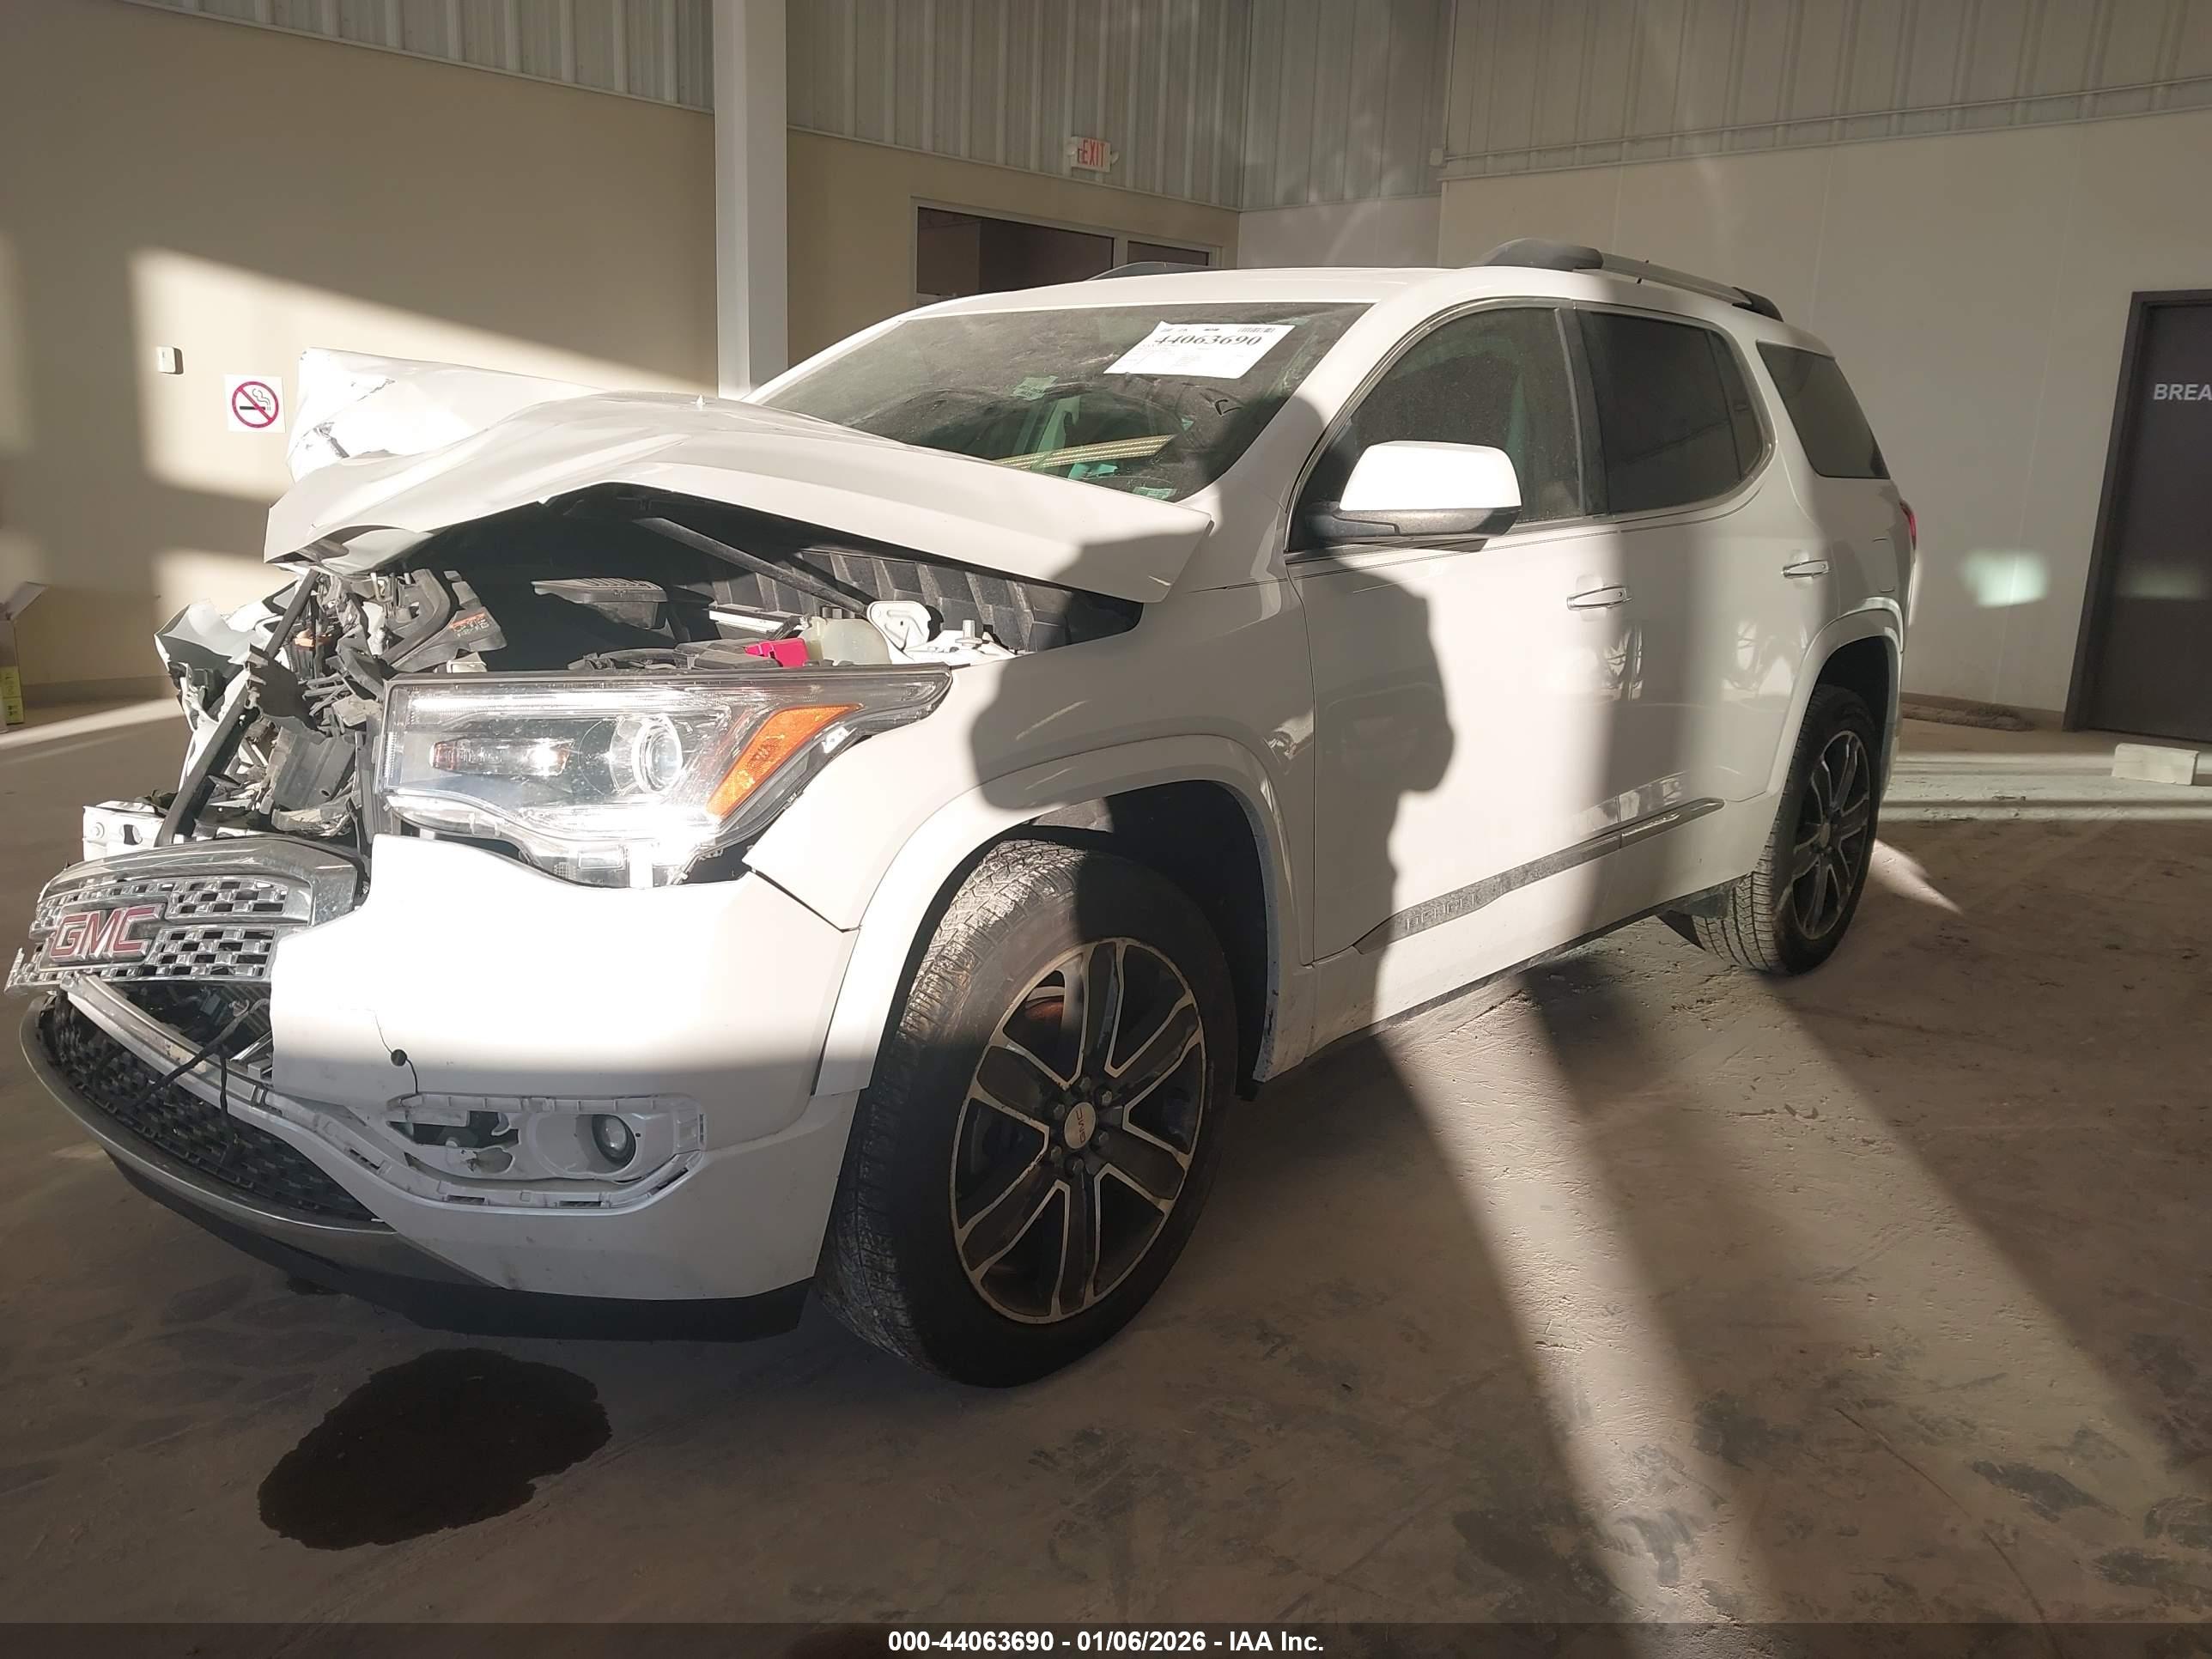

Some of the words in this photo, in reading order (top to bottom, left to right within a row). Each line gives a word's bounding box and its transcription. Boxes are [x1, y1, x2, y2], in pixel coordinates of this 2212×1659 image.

[1082, 138, 1106, 167] EXIT
[1154, 335, 1262, 346] 44063690
[2153, 383, 2212, 400] BREA
[50, 902, 163, 963] GMC
[1075, 1107, 1086, 1144] GMC
